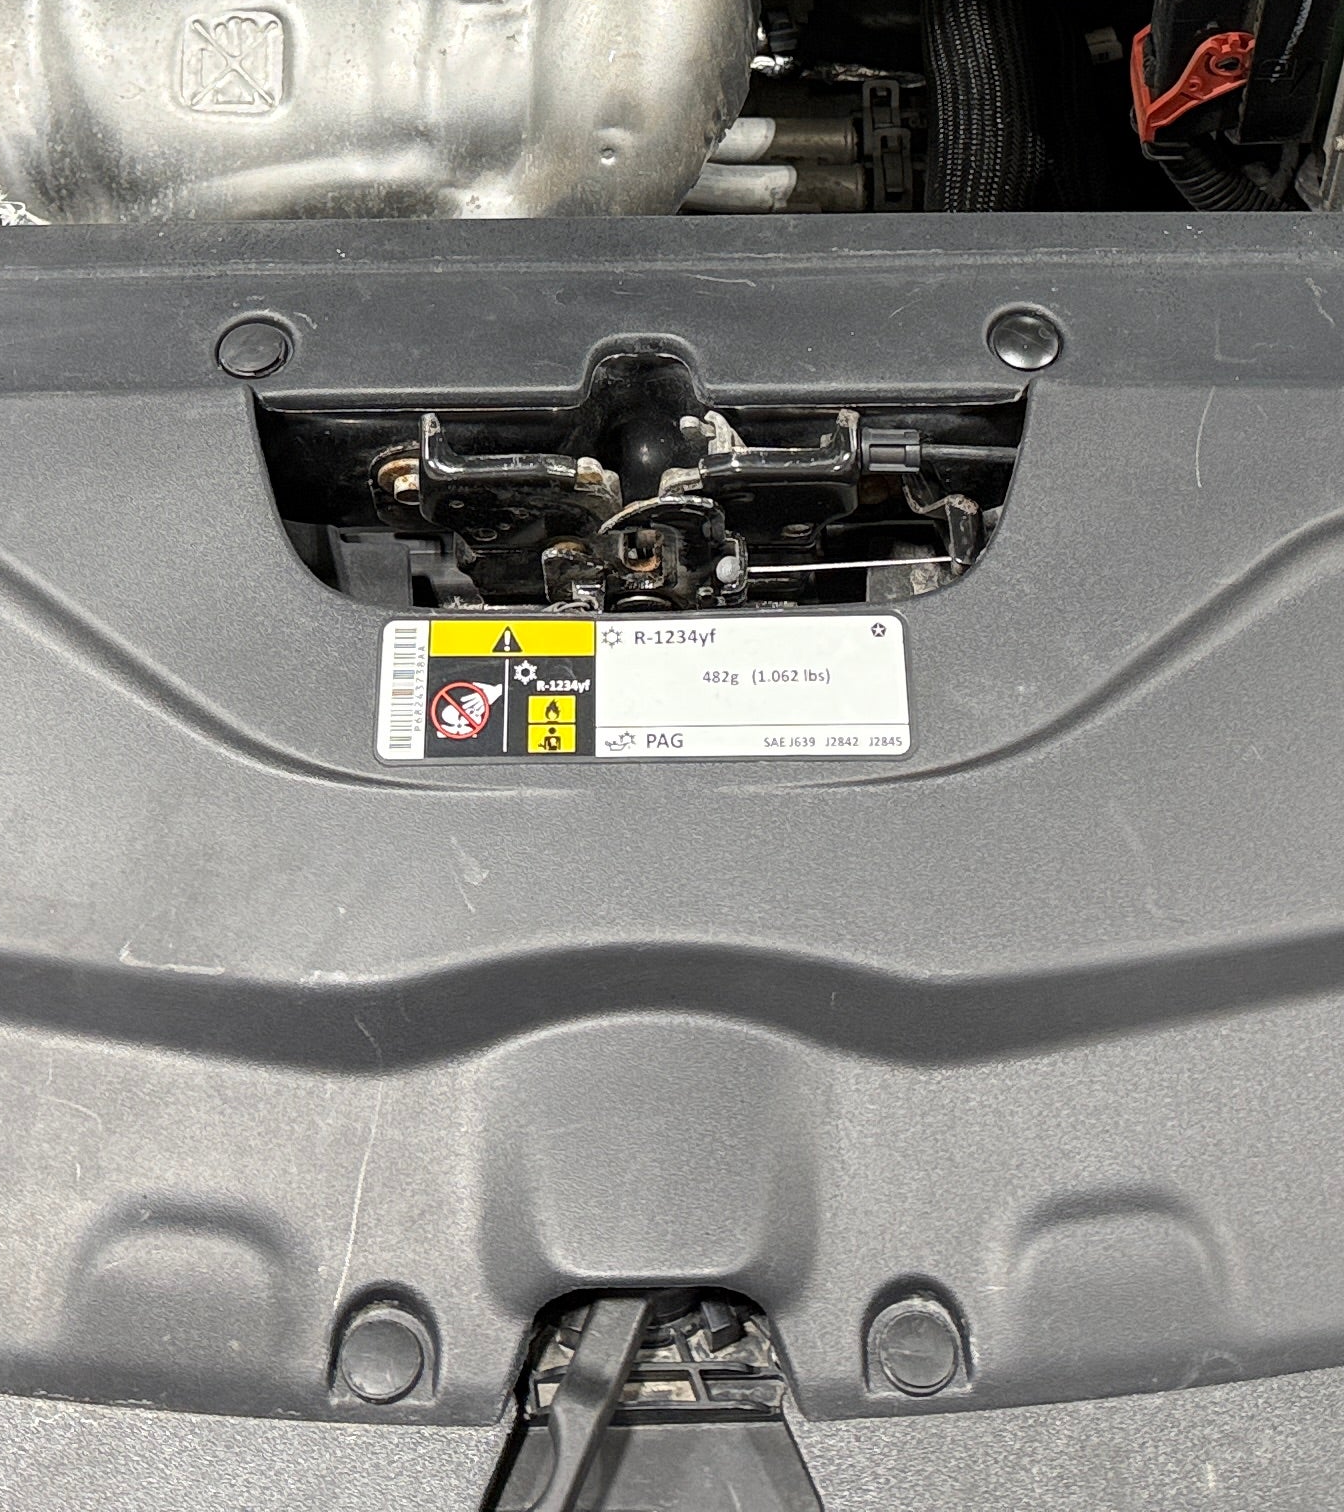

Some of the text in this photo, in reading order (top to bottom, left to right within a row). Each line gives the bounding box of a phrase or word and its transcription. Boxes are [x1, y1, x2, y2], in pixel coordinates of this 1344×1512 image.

[634, 628, 717, 647] R-1234yf
[702, 668, 831, 685] 482g (1.062 lbs)
[536, 679, 591, 694] R-1234yf
[646, 733, 903, 749] PAG SAE J639 J2842 J2845
